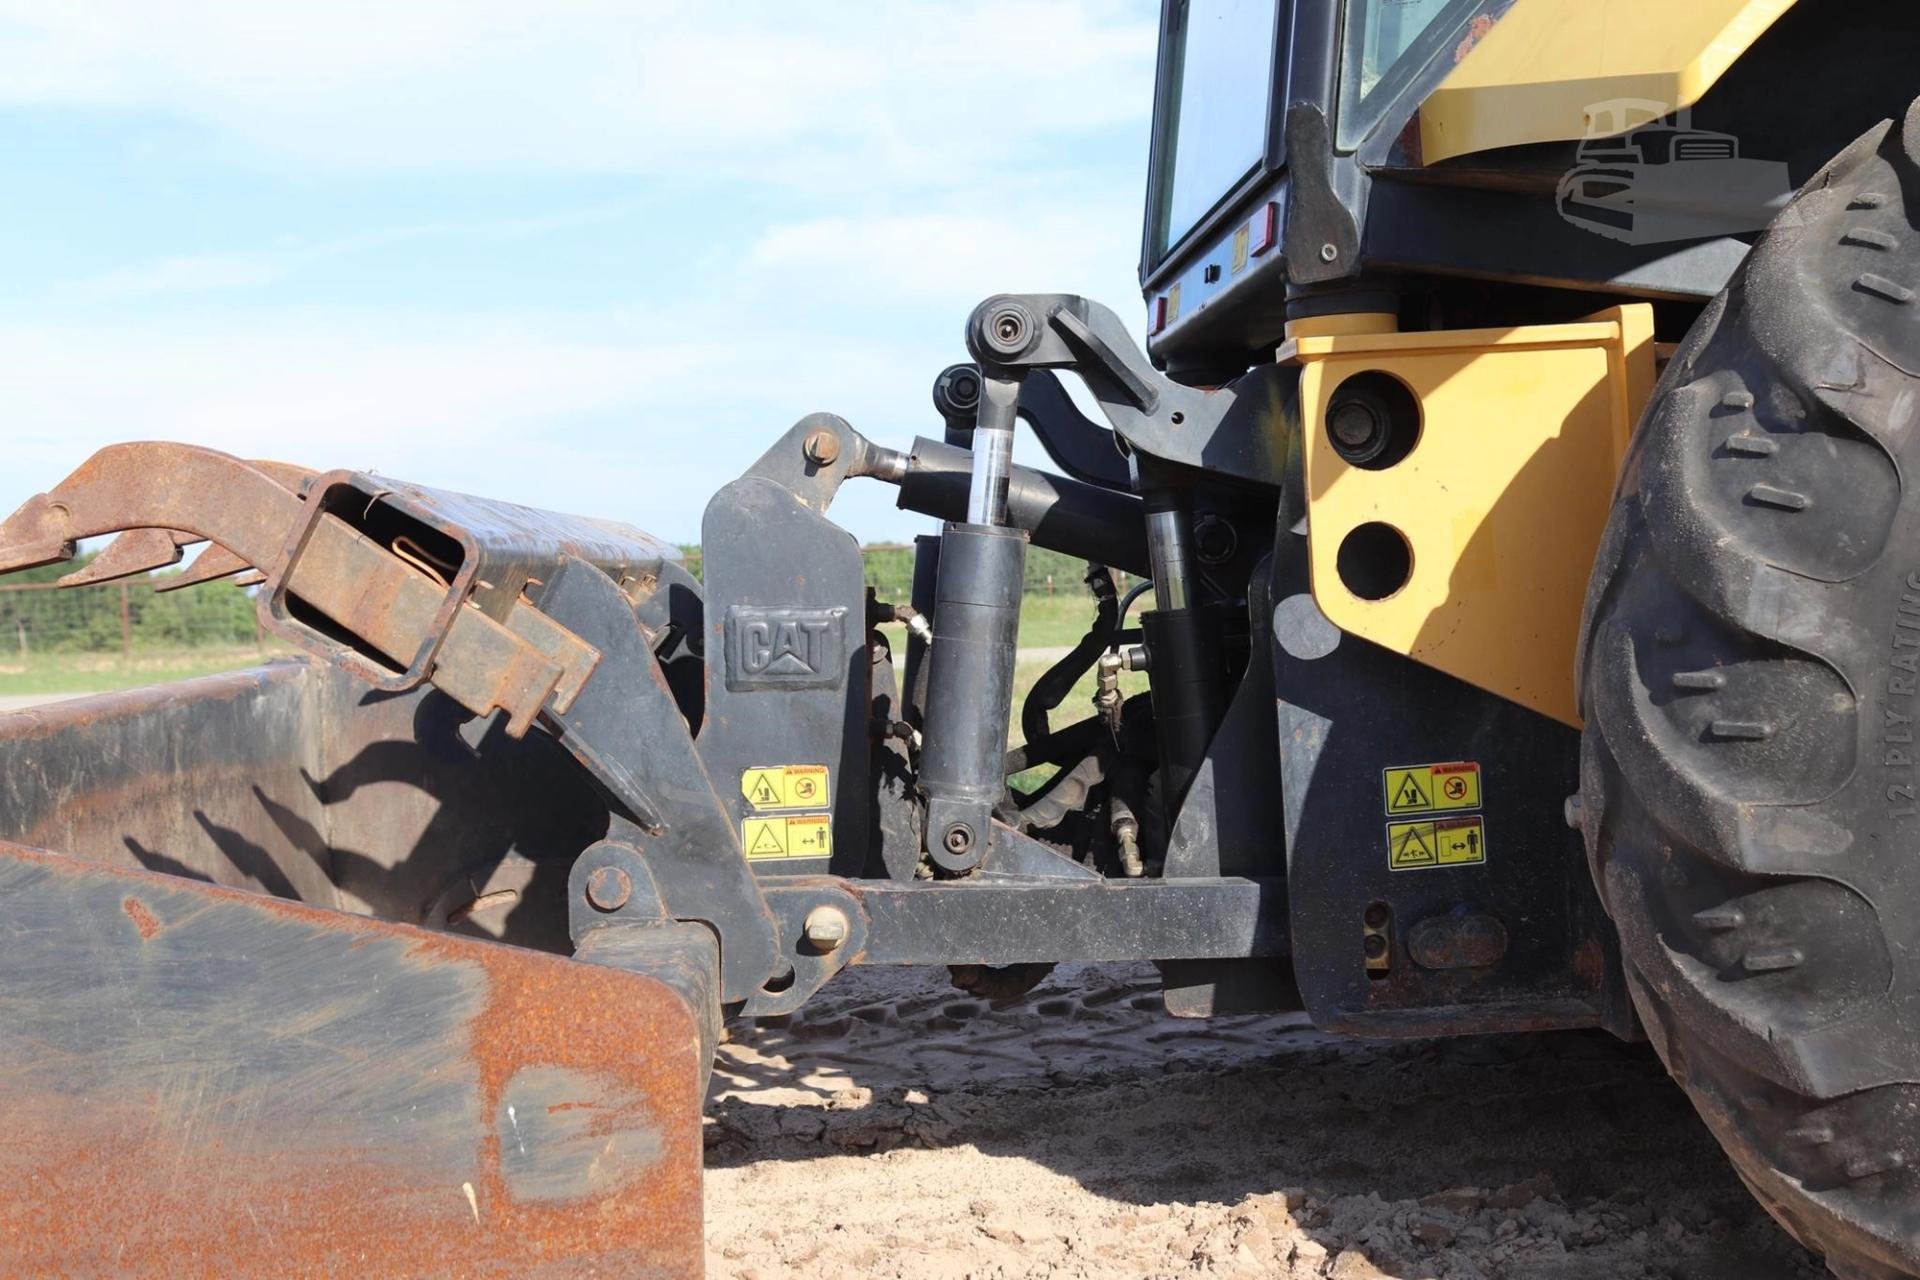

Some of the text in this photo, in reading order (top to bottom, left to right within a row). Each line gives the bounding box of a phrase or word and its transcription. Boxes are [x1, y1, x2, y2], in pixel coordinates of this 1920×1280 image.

[742, 622, 829, 673] CAT
[1884, 709, 1913, 766] PLY
[794, 767, 825, 775] WARNING
[1886, 784, 1917, 820] 12
